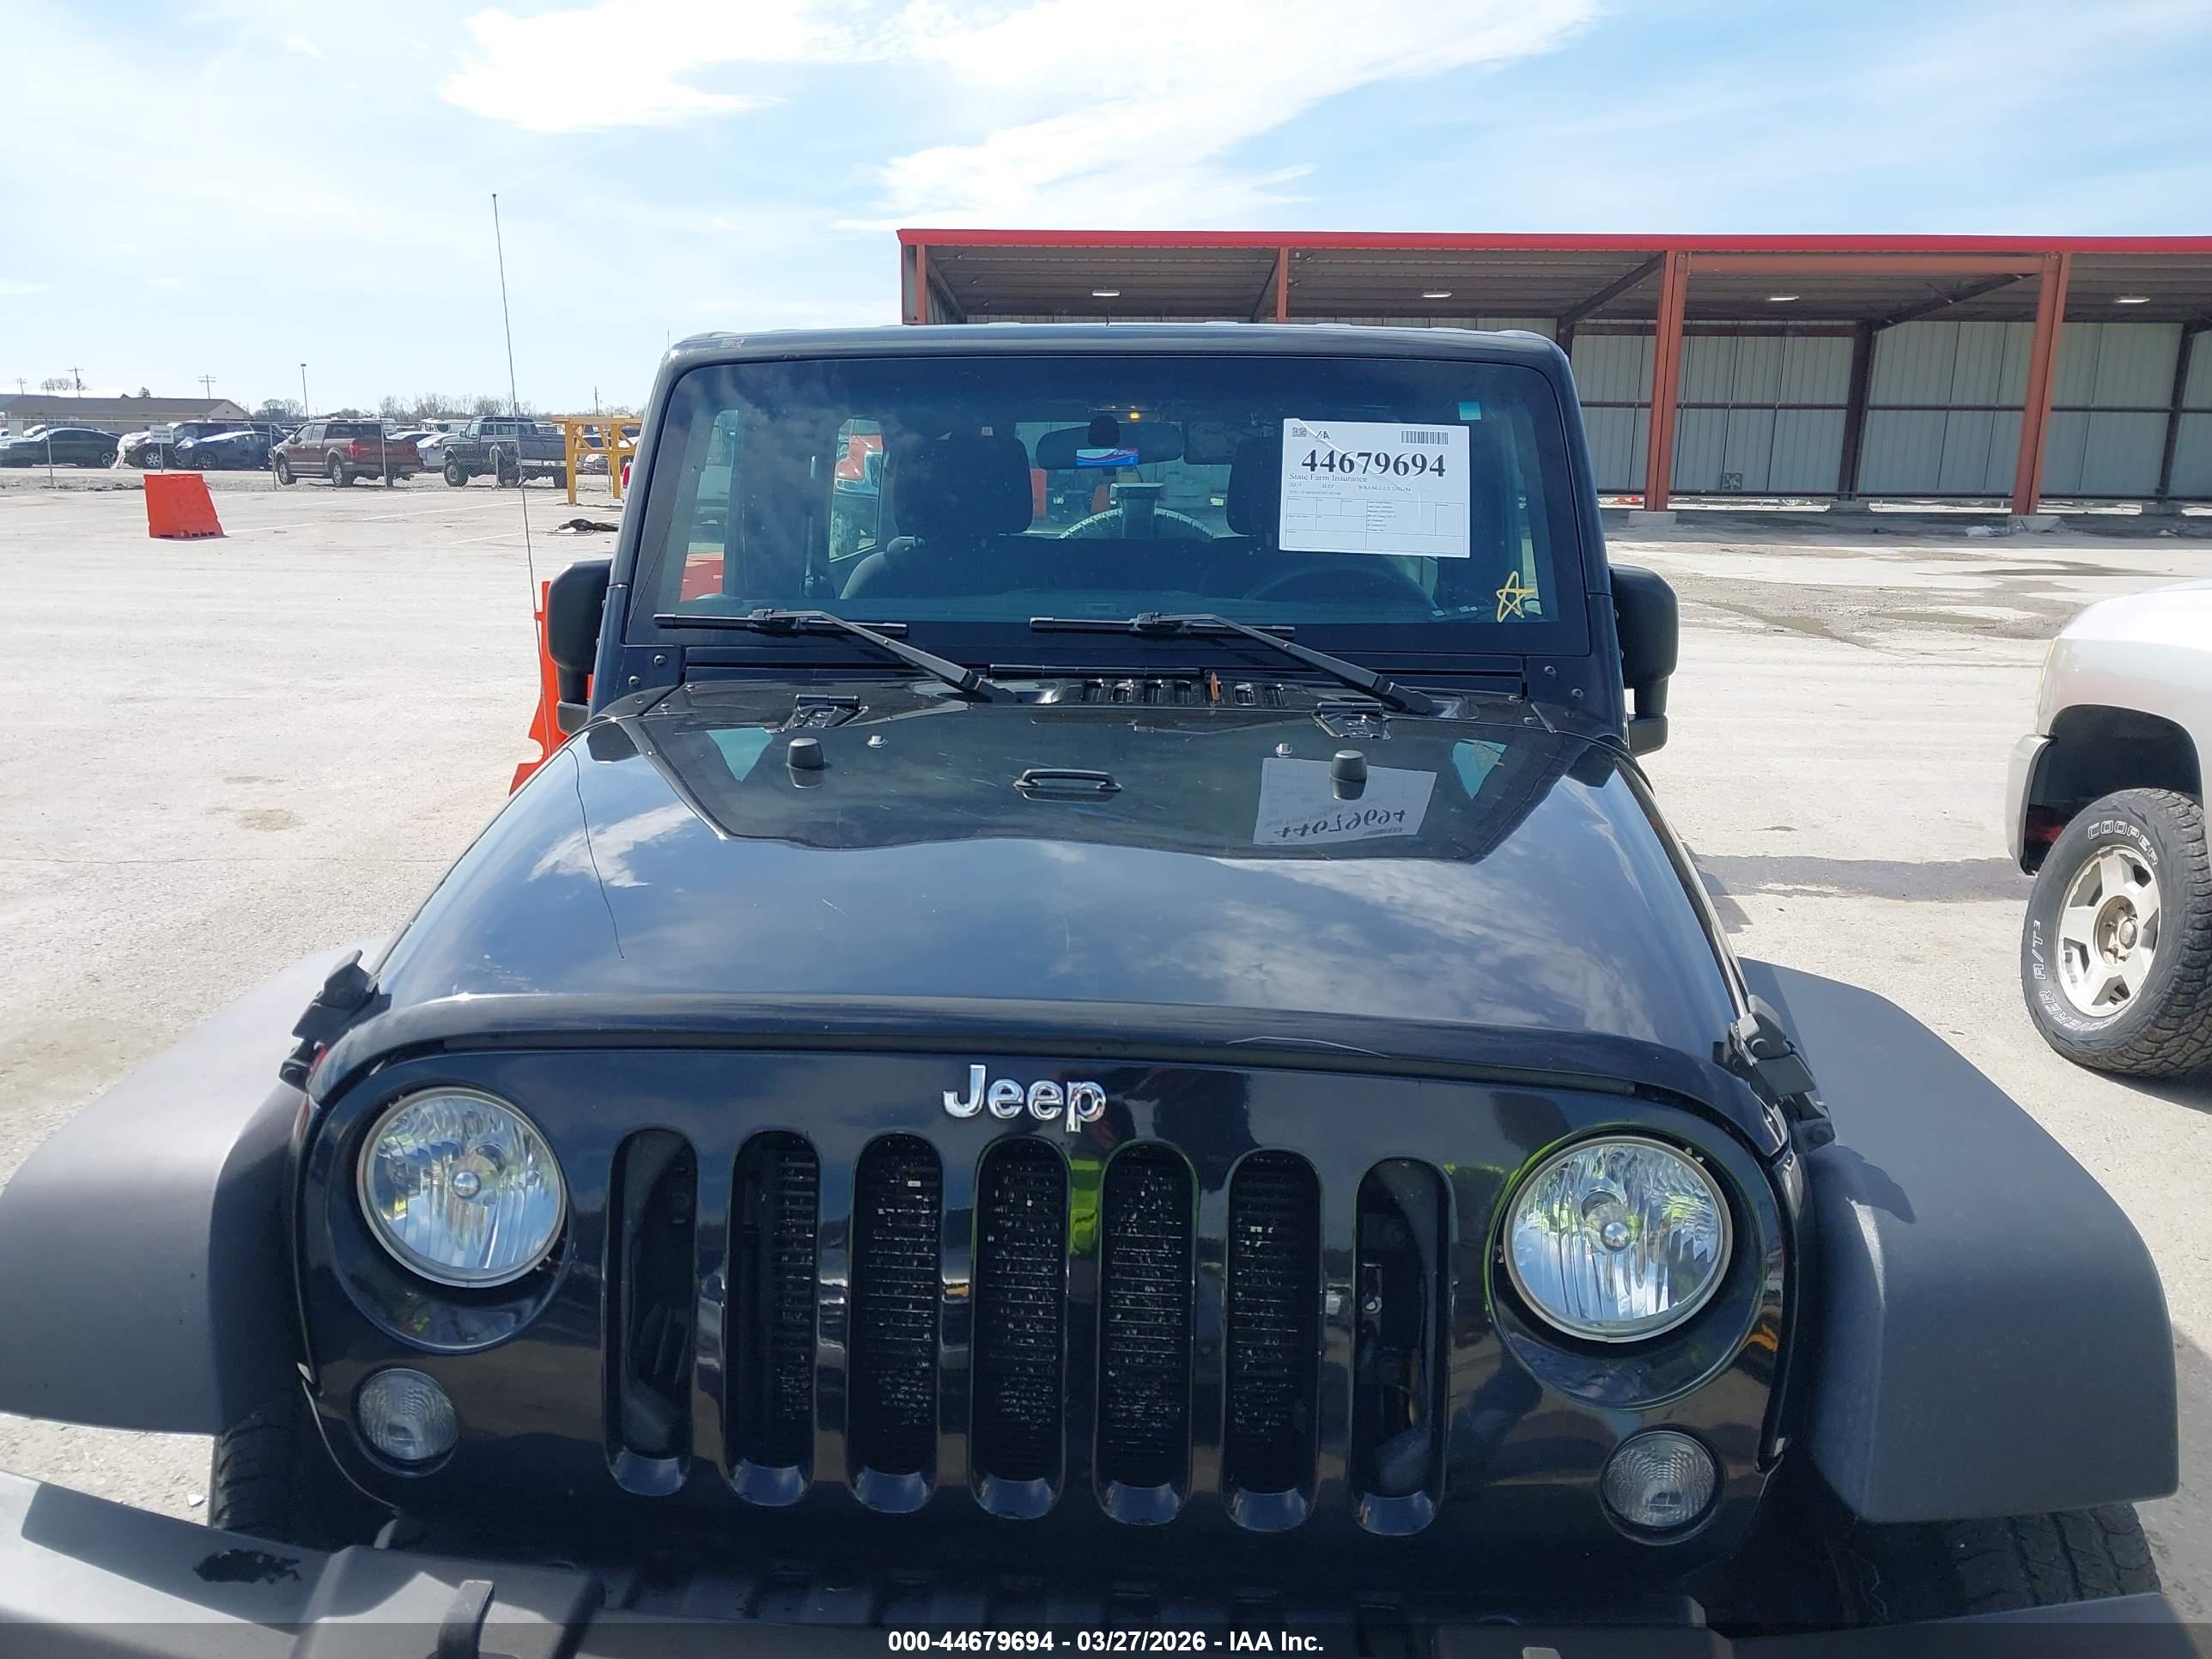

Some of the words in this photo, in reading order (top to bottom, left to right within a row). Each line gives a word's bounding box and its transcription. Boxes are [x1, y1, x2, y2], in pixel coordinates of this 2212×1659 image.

[1301, 449, 1446, 477] 44679694
[1332, 474, 1368, 483] Insurance
[2087, 820, 2159, 867] COOPER
[943, 1064, 1107, 1133] Jeep
